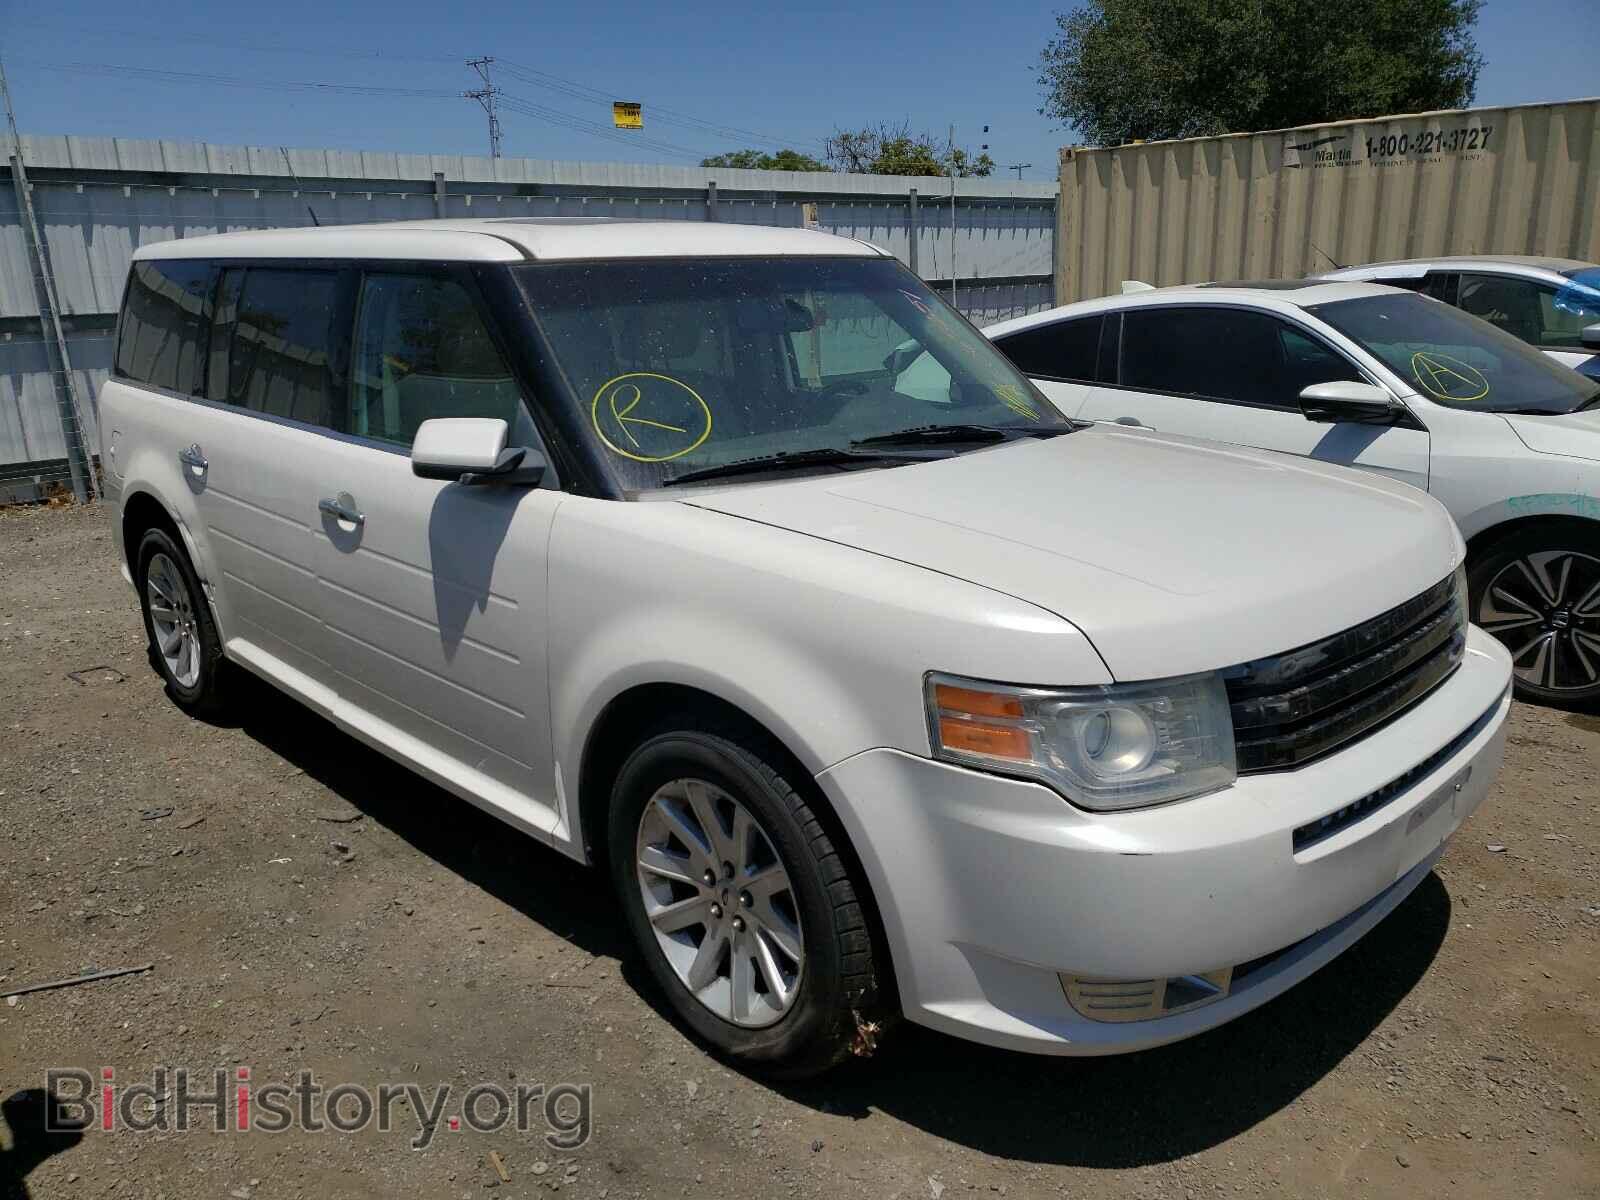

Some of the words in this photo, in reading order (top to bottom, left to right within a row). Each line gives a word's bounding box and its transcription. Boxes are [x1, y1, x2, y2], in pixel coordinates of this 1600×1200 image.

[1314, 148, 1352, 162] Martin
[1416, 353, 1480, 394] A
[610, 384, 687, 448] R
